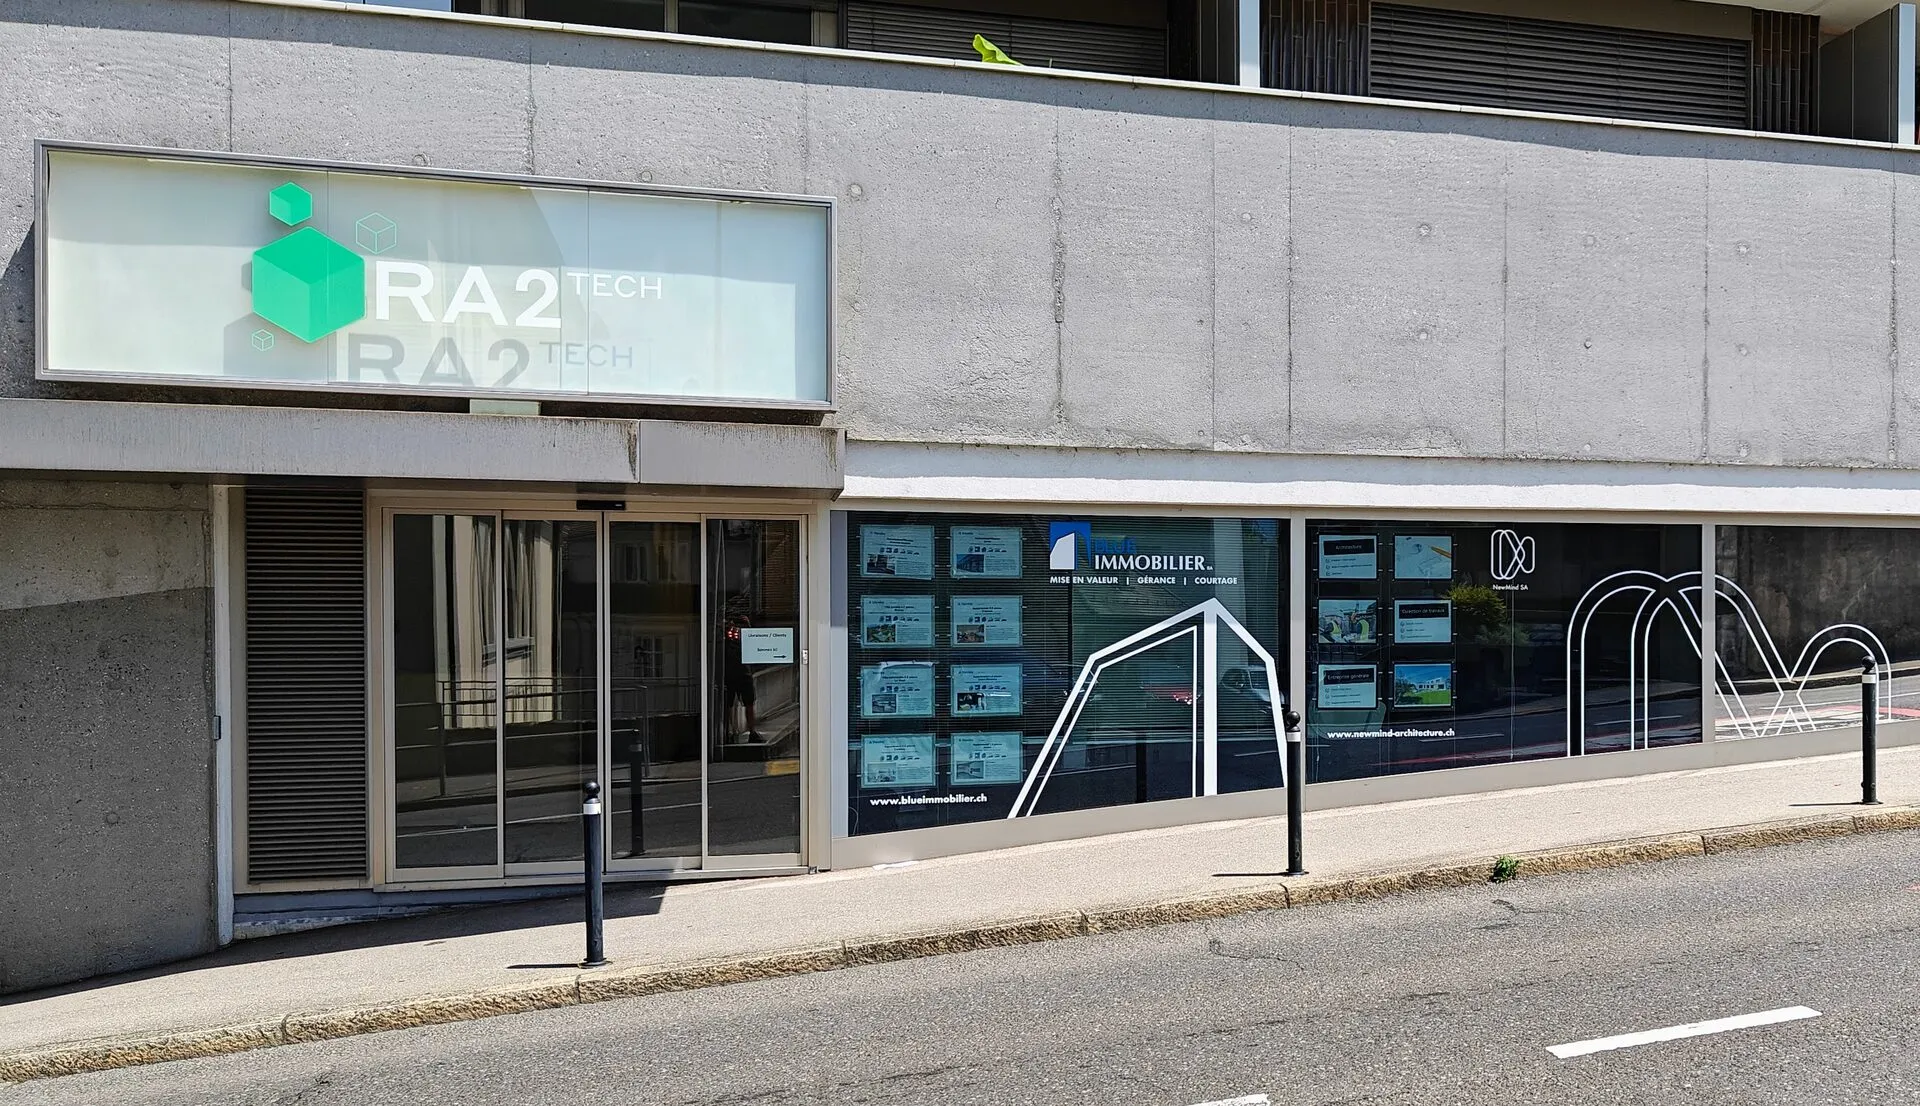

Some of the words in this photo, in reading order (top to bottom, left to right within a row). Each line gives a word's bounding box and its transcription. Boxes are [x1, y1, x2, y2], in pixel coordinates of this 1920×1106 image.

[375, 260, 563, 328] RA2
[567, 272, 664, 300] TECH
[1094, 555, 1205, 570] IMMOBILIER
[1049, 576, 1070, 584] MISE
[1072, 576, 1084, 584] EN
[1086, 576, 1119, 584] VALEUR
[1137, 574, 1176, 585] GÉRANCE
[1194, 576, 1238, 585] COURTAGE
[1327, 729, 1455, 739] www.newmind-architecture.ch
[870, 793, 988, 806] www.blueimmobilier.ch
